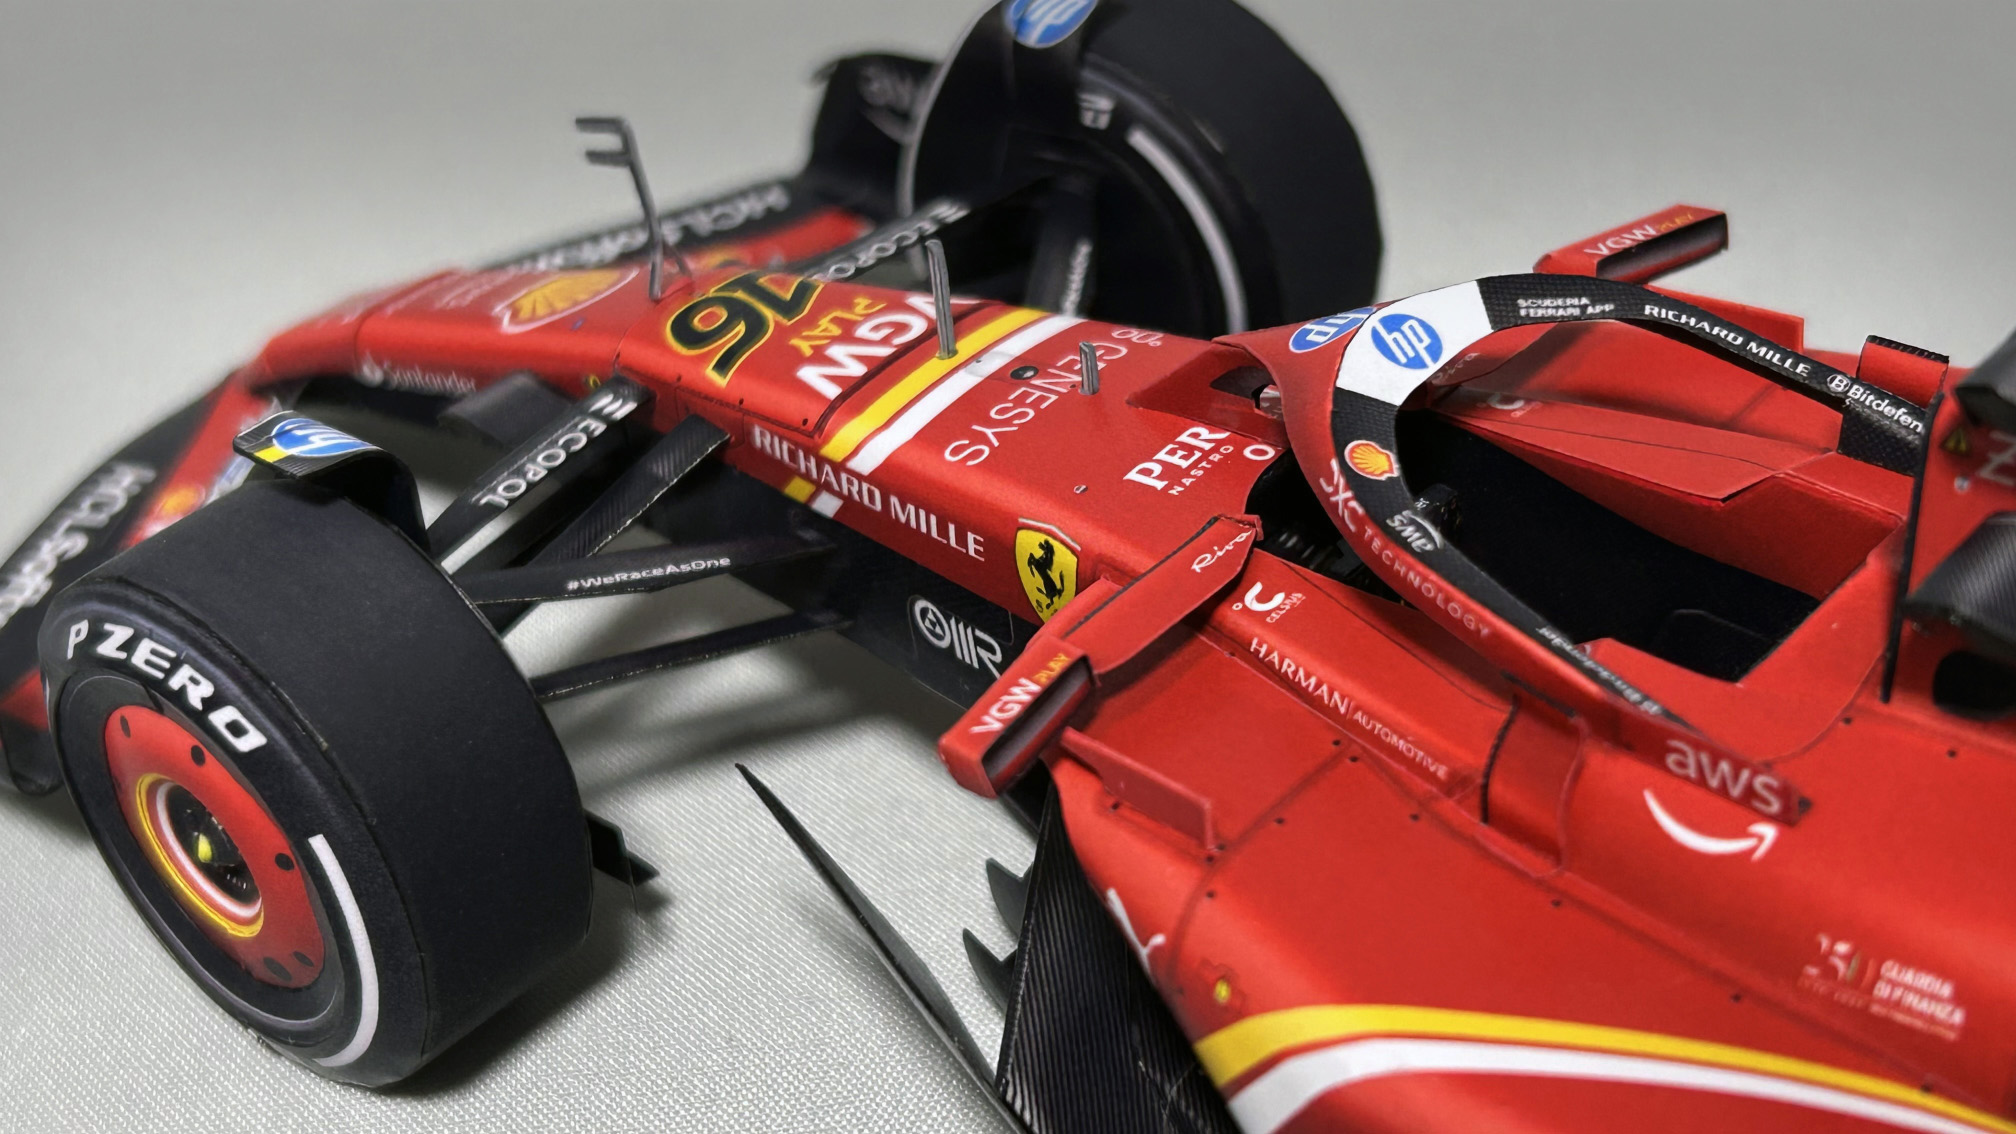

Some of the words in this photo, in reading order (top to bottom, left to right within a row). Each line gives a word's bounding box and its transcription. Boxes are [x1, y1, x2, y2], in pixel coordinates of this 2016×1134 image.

[1583, 224, 1657, 256] VGW
[666, 270, 826, 388] 16
[788, 296, 887, 356] PLAY
[1373, 308, 1441, 369] hp
[1517, 297, 1591, 308] SCUDERIA
[1519, 307, 1581, 318] FERRARI
[1585, 303, 1615, 316] APP
[1644, 304, 1743, 346] RICHARD
[1746, 341, 1811, 377] MILLE
[796, 295, 985, 401] VGW
[944, 342, 1128, 466] GENESYS
[479, 418, 607, 509] ECOPOL
[753, 424, 882, 512] RICHARD
[890, 495, 985, 562] MILLE
[1168, 445, 1234, 495] NASTRO
[567, 556, 731, 590] #WeRaceAsOne
[1191, 530, 1255, 573] Riva
[1364, 526, 1491, 637] TECHNOLOGY
[67, 619, 89, 660] P
[96, 623, 268, 753] ZERO
[968, 677, 1041, 734] VGW
[1032, 652, 1071, 685] PLAY
[1250, 637, 1348, 714] HARMAN
[1353, 709, 1448, 781] AUTOMOTIVE
[1665, 739, 1782, 815] aws
